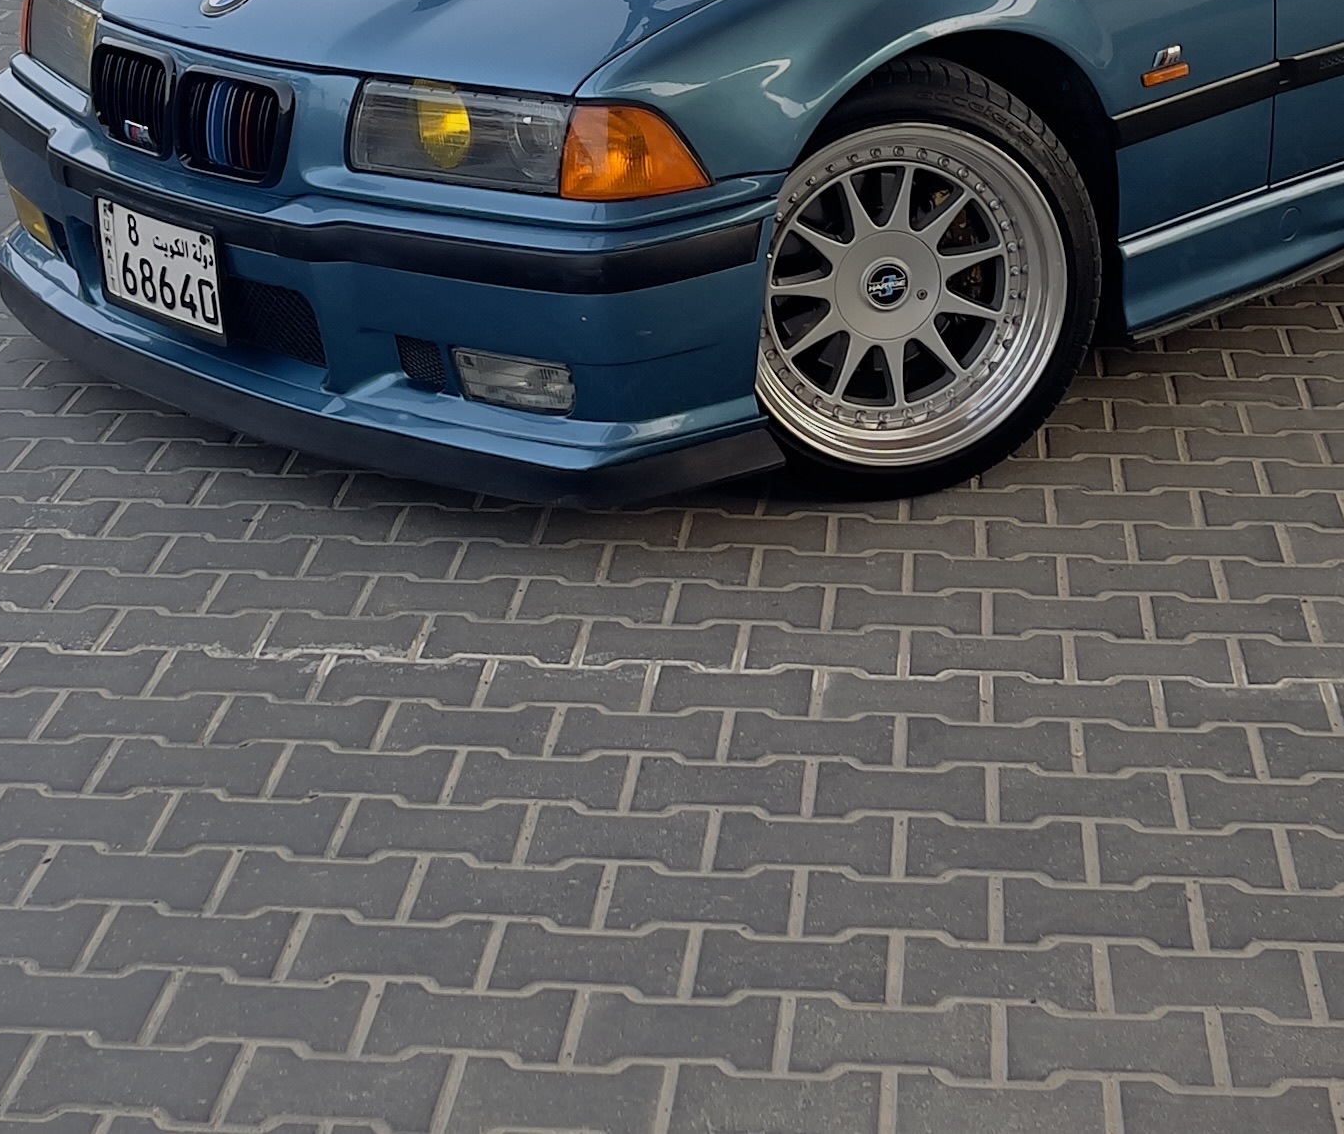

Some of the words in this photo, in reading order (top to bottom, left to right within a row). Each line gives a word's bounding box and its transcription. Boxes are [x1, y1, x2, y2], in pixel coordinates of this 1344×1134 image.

[127, 214, 139, 246] 8
[152, 236, 189, 259] الكويت
[192, 243, 214, 270] دولة
[122, 252, 219, 325] 68640
